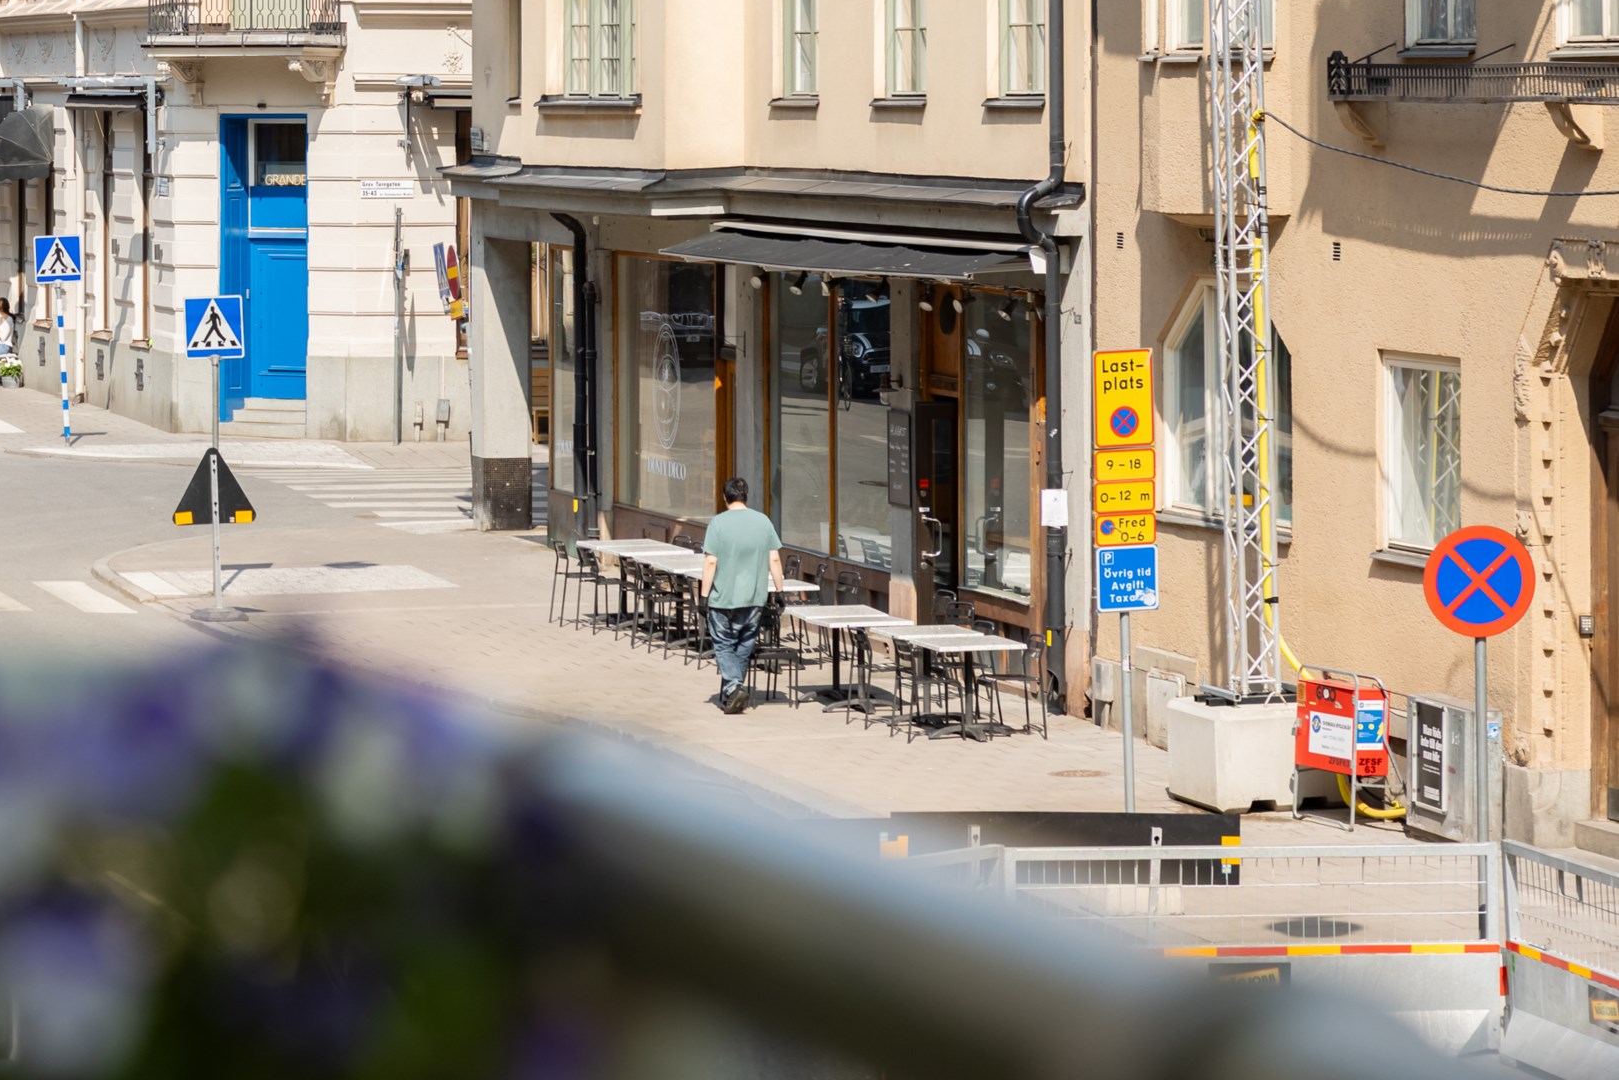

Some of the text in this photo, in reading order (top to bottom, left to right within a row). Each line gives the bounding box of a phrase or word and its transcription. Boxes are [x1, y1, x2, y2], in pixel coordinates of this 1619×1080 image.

[264, 174, 307, 186] GRANDE
[1102, 358, 1144, 374] Last-
[1103, 376, 1144, 394] plats
[647, 457, 687, 481] DUSTY DECO
[1140, 491, 1150, 501] m
[1119, 517, 1147, 528] Fred
[1121, 531, 1145, 542] 0-6
[1104, 567, 1151, 579] Övrig tid
[1111, 580, 1145, 592] Avgift
[1110, 593, 1136, 604] Taxa
[1359, 758, 1382, 766] ZFSF
[1364, 766, 1376, 774] 63
